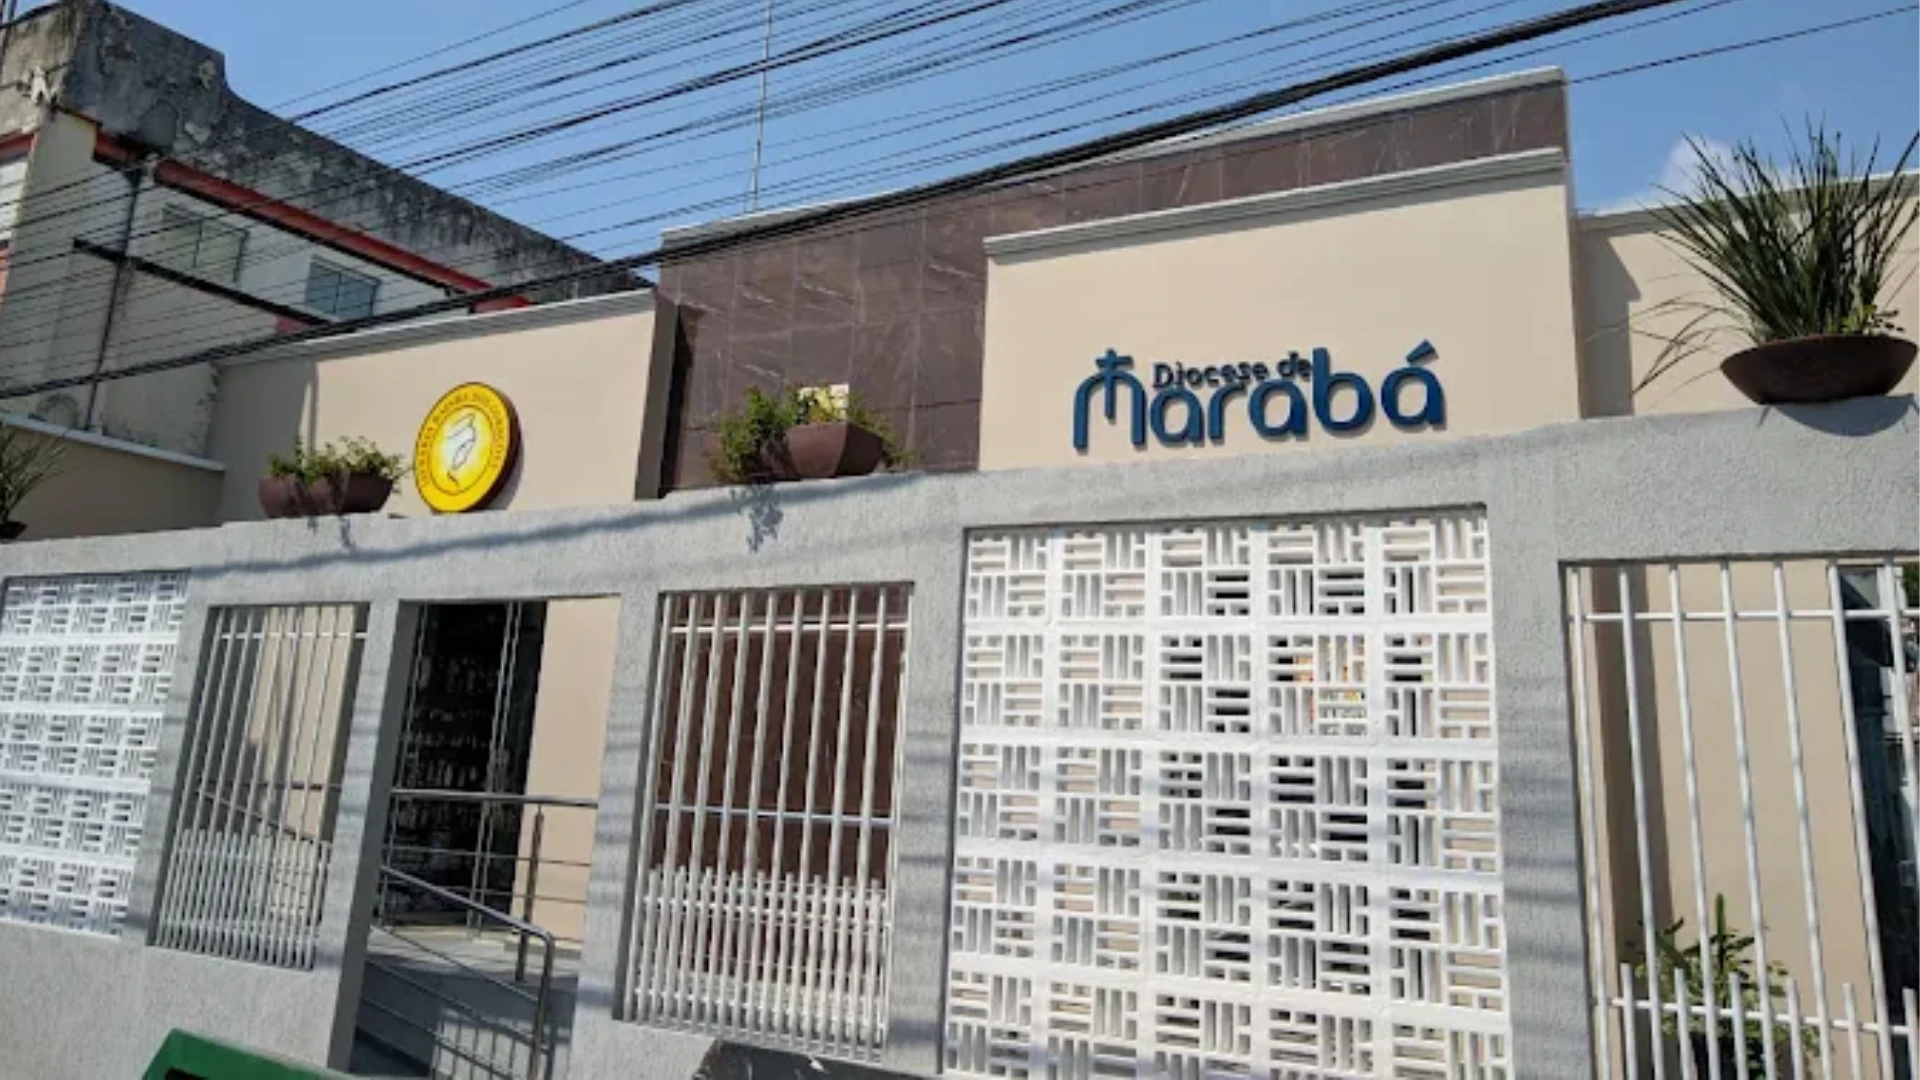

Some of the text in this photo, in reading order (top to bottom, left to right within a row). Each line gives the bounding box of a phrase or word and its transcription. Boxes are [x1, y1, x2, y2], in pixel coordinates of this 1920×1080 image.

[1073, 339, 1446, 452] Marabá
[1153, 351, 1313, 390] Diocese de
